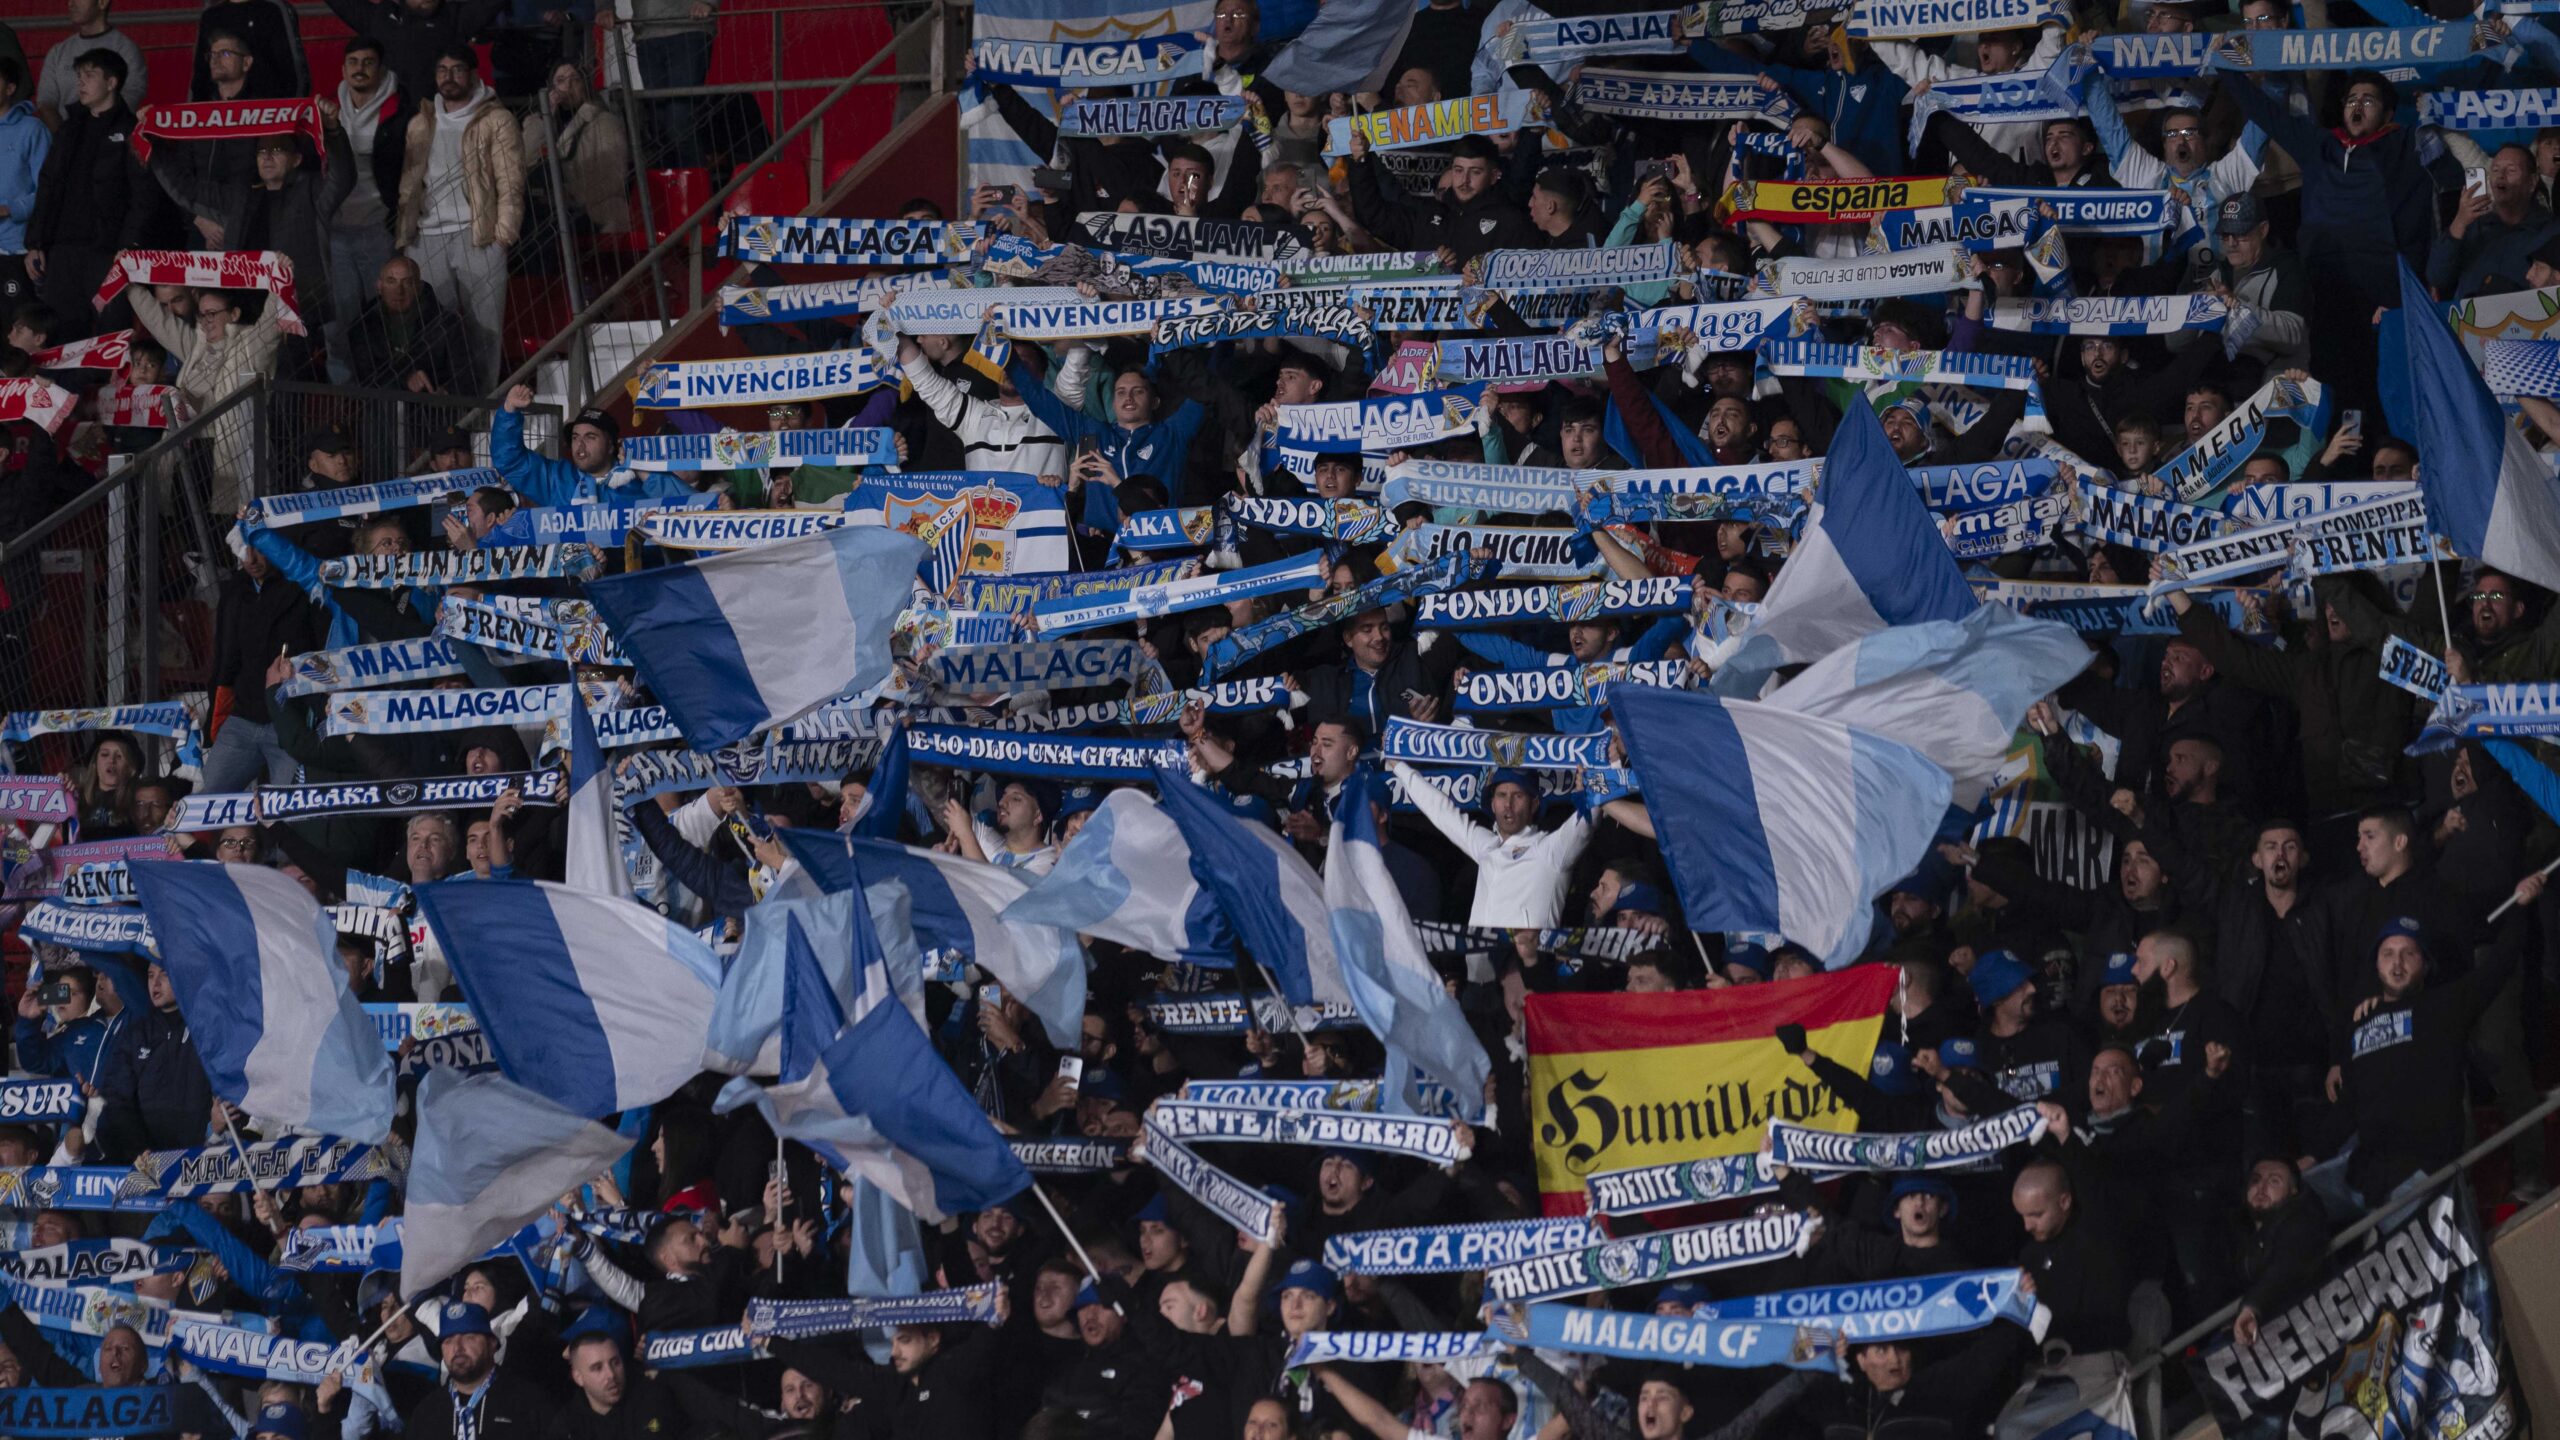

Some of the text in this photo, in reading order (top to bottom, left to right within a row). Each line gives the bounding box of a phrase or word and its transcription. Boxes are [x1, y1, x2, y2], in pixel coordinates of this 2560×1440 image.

[1872, 0, 2025, 27] INVENCIBLES
[979, 40, 1146, 77] MALAGA
[2281, 27, 2445, 65] MALAGA CF
[1078, 98, 1231, 136] MÁLAGA CF
[1352, 95, 1508, 147] BENAMIEL
[1791, 182, 1908, 220] españa
[1839, 212, 1874, 220] MALAGA
[2057, 200, 2152, 220] TE QUIERO
[784, 226, 935, 255] MALAGA
[1902, 207, 2040, 248] MALAGAC
[1309, 251, 1416, 275] COMEPIPAS
[1497, 244, 1666, 280] 100% MALAGUISTA
[779, 271, 941, 311] MALAGA
[889, 303, 959, 324] MALAGA
[1010, 297, 1193, 329] INVENCIBLES
[1366, 296, 1463, 323] FRENTE
[688, 352, 854, 374] JUNTOS SOMOS
[1463, 338, 1594, 379] MÁLAGA
[1774, 342, 1859, 367] ALAKA
[687, 363, 853, 396] INVENCIBLES
[1289, 398, 1434, 441] MALAGA
[780, 428, 881, 456] HINCHAS
[2170, 402, 2264, 491] AMEDA
[864, 477, 892, 488] ALAGA
[1921, 461, 2028, 507] LAGA
[662, 514, 829, 540] INVENCIBLES
[1228, 497, 1327, 529] ONDO
[2090, 494, 2213, 546] MALAGA
[1482, 530, 1575, 563] HICIMO
[2184, 530, 2295, 574] FRENTE
[2308, 526, 2428, 568] FRENTE
[1419, 577, 1679, 622] FONDO SUR
[461, 607, 558, 652] FRENTE
[941, 645, 1134, 685] MALAGA
[597, 707, 677, 738] ALAGA
[1000, 700, 1119, 732] ONDO
[2514, 722, 2560, 737] SENTIMIEN
[935, 733, 1170, 769] LO DIJO UNA GITANA
[1390, 725, 1590, 765] FONDO SUR
[24, 774, 64, 785] SIEMPR
[260, 784, 380, 816] MALAKA
[64, 868, 136, 899] RENTE
[1148, 996, 1246, 1026] FRENTE
[1, 1081, 74, 1119] SUR
[1541, 1066, 1853, 1178] Humillader
[1425, 1233, 1453, 1264] A
[183, 1323, 359, 1378] MALAGA
[1561, 1309, 1762, 1359] MALAGA CF
